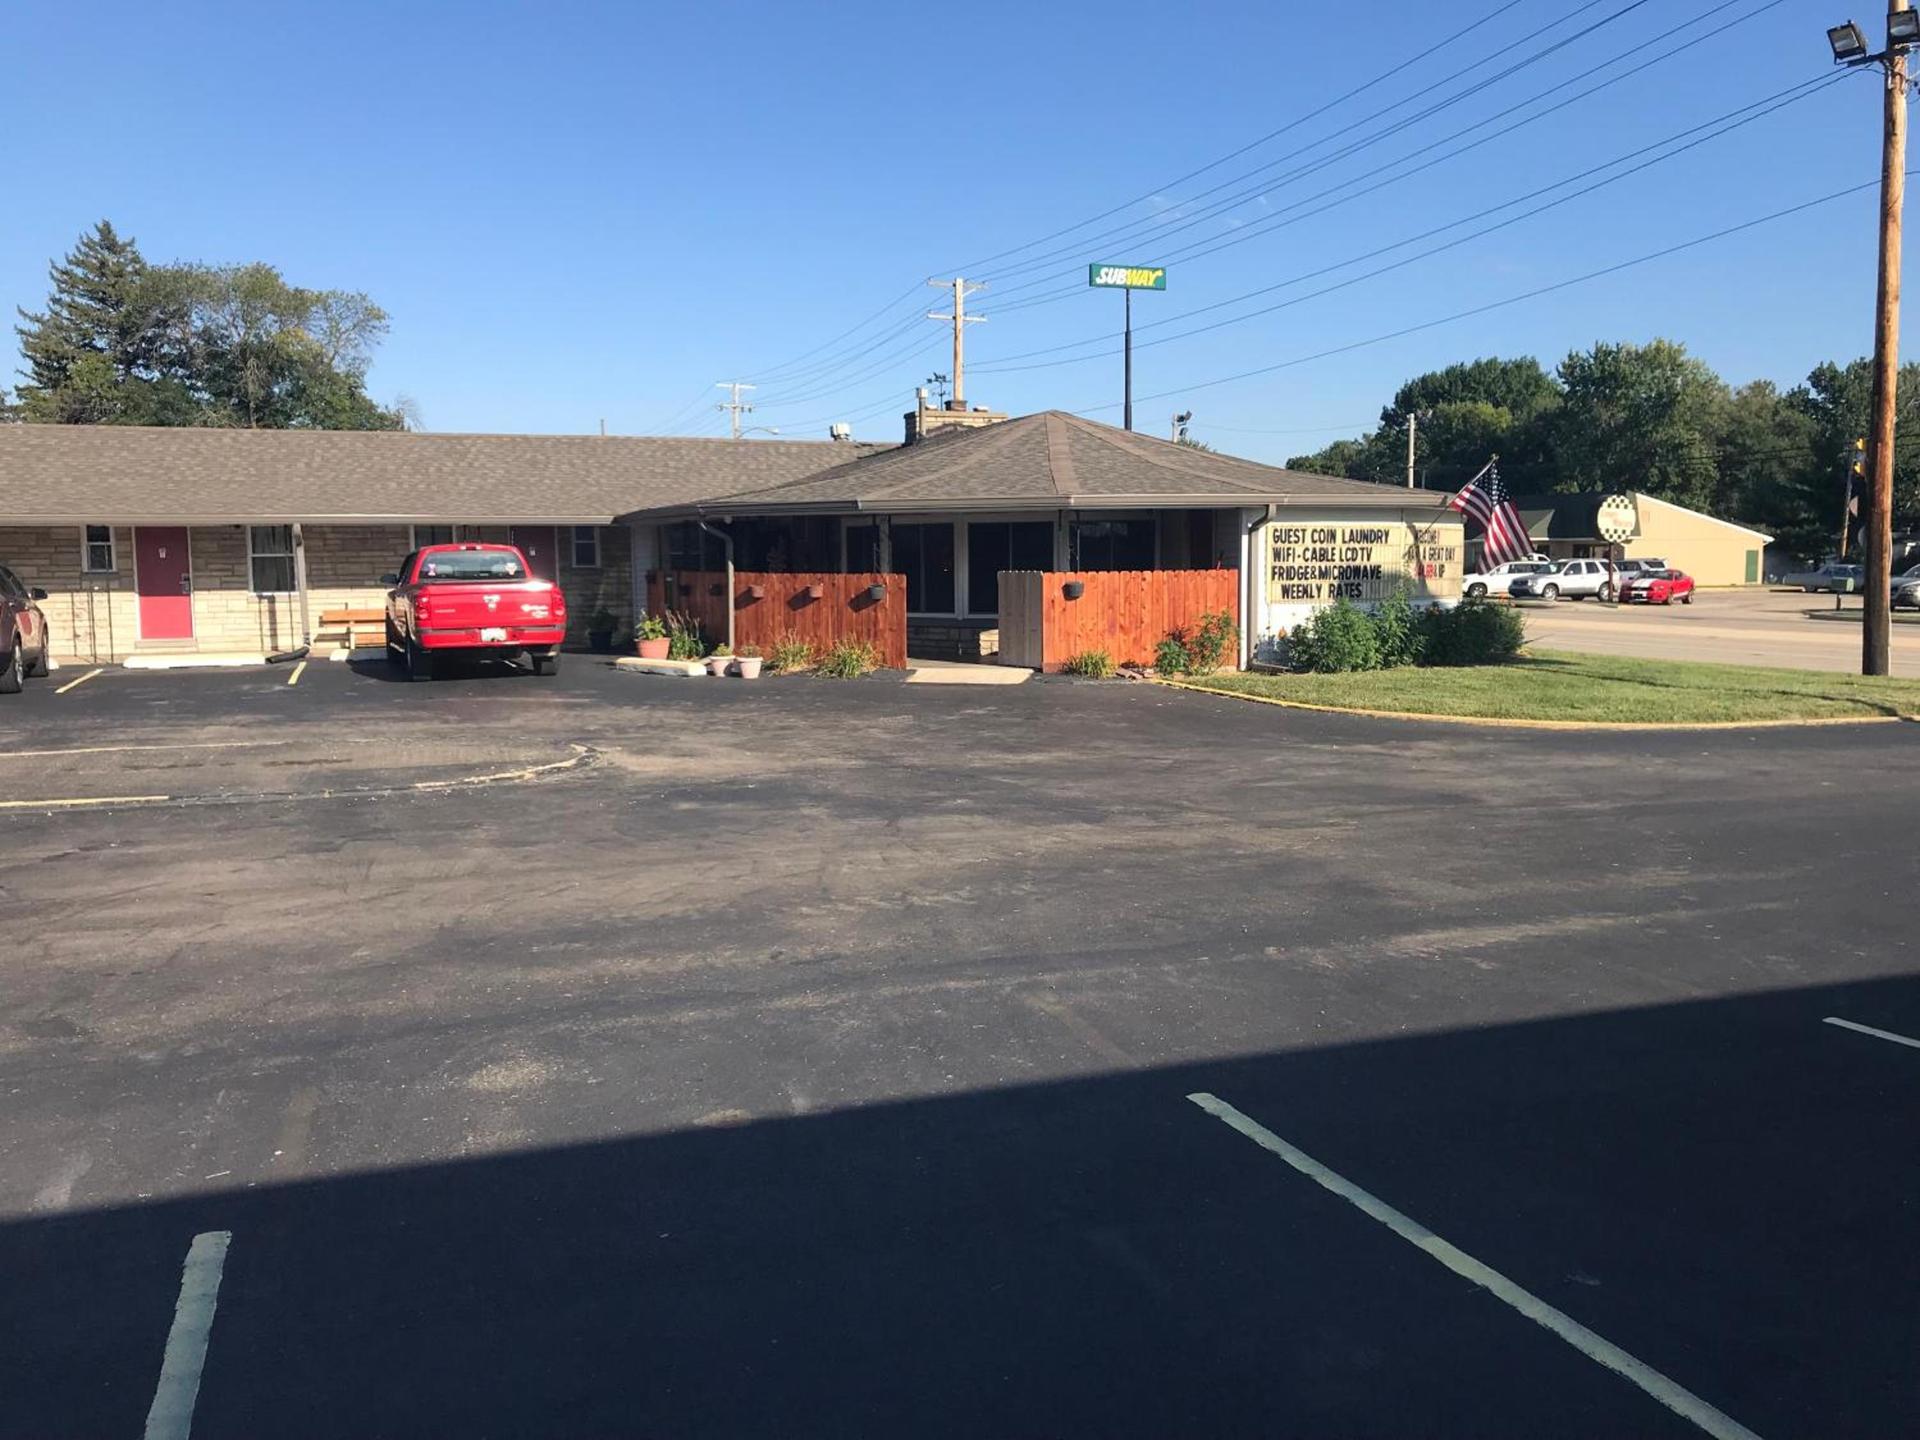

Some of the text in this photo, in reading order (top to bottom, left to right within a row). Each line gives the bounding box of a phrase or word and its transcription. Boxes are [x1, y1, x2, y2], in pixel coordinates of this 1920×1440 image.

[1095, 267, 1163, 286] SUBWAY
[1272, 529, 1390, 544] GUEST COIN LAUNDRY
[1281, 582, 1362, 599] WEEKLY RATES
